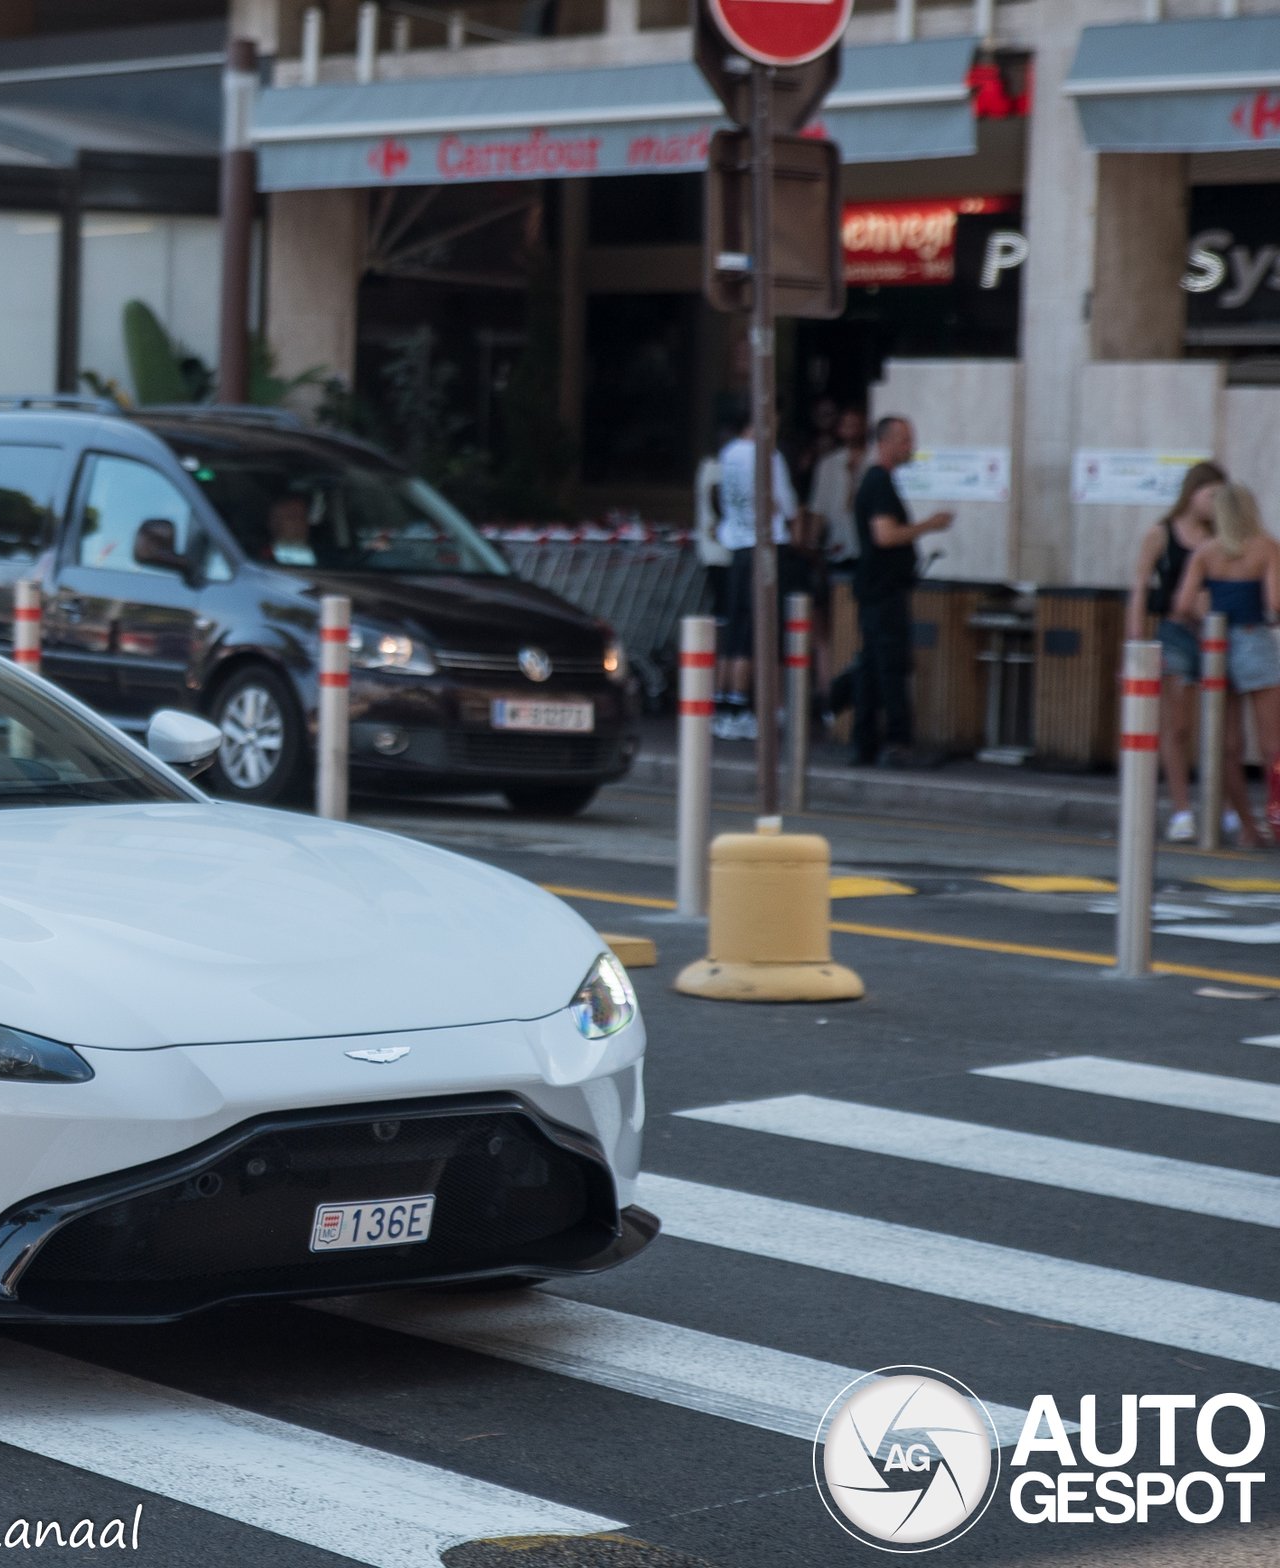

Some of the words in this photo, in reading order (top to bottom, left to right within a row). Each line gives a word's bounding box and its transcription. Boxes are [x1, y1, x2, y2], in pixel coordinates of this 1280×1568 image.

[437, 126, 601, 179] Carrefour
[322, 1228, 337, 1239] MC
[352, 1203, 428, 1242] 136E
